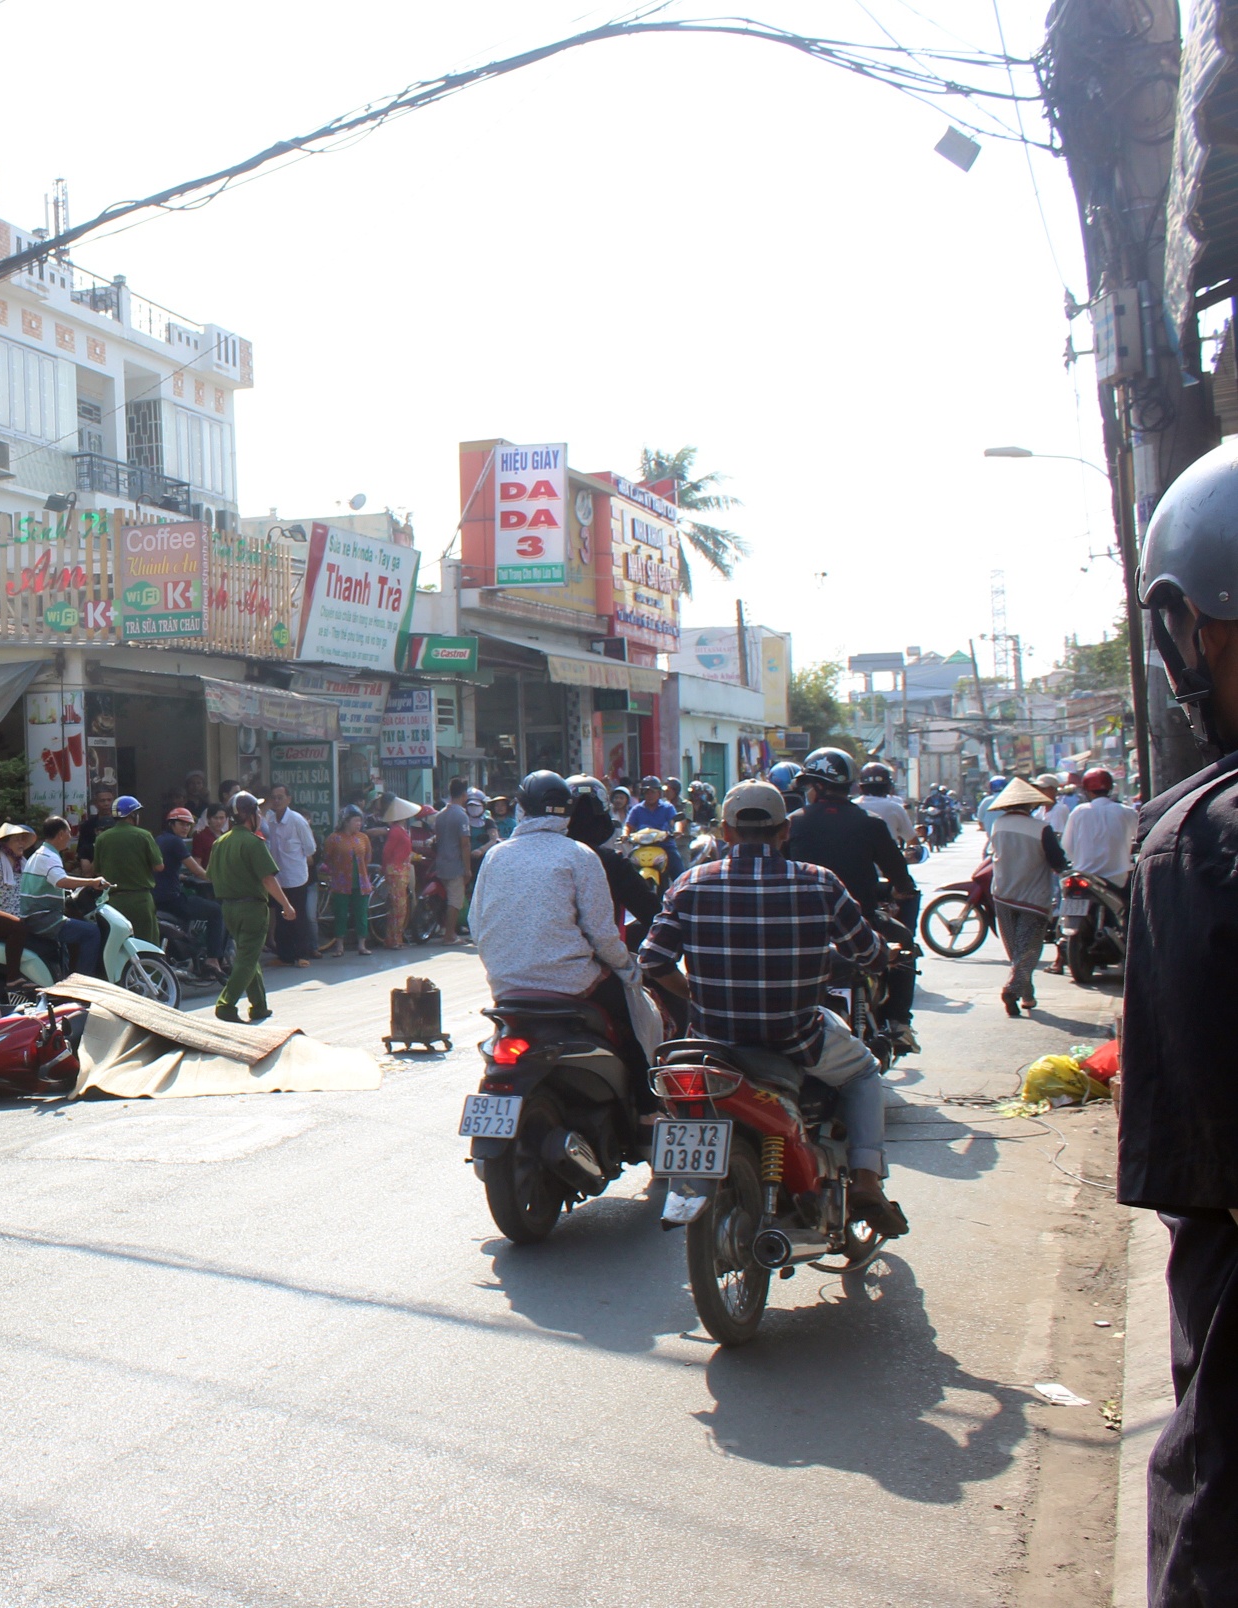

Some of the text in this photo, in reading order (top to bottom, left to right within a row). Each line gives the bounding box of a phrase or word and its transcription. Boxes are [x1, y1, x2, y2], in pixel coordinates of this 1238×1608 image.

[501, 446, 559, 475] HIỆU GIÀY
[500, 480, 561, 503] DA
[15, 516, 68, 543] Sinh
[500, 509, 561, 531] DA
[127, 527, 196, 552] Coffee
[516, 535, 545, 559] 3
[127, 552, 198, 577] Khánh An
[342, 544, 351, 557] xe
[353, 541, 374, 563] Honda
[378, 548, 391, 568] Tay
[392, 555, 401, 572] ga
[6, 549, 88, 597] An
[325, 563, 402, 613] Thanh Trà
[201, 591, 209, 631] Coffee
[125, 613, 201, 634] TRÀ SỮA TRÂN CHÂU
[439, 649, 468, 659] Castrol
[382, 730, 396, 743] TAY
[285, 746, 325, 759] Castrol
[272, 764, 330, 784] CHUYÊN SỬA
[319, 789, 330, 805] XE
[311, 810, 330, 826] GA
[471, 1097, 511, 1116] 59-L1
[462, 1115, 513, 1135] 957.23
[666, 1125, 718, 1148] 52-X2
[663, 1149, 716, 1171] 0389
